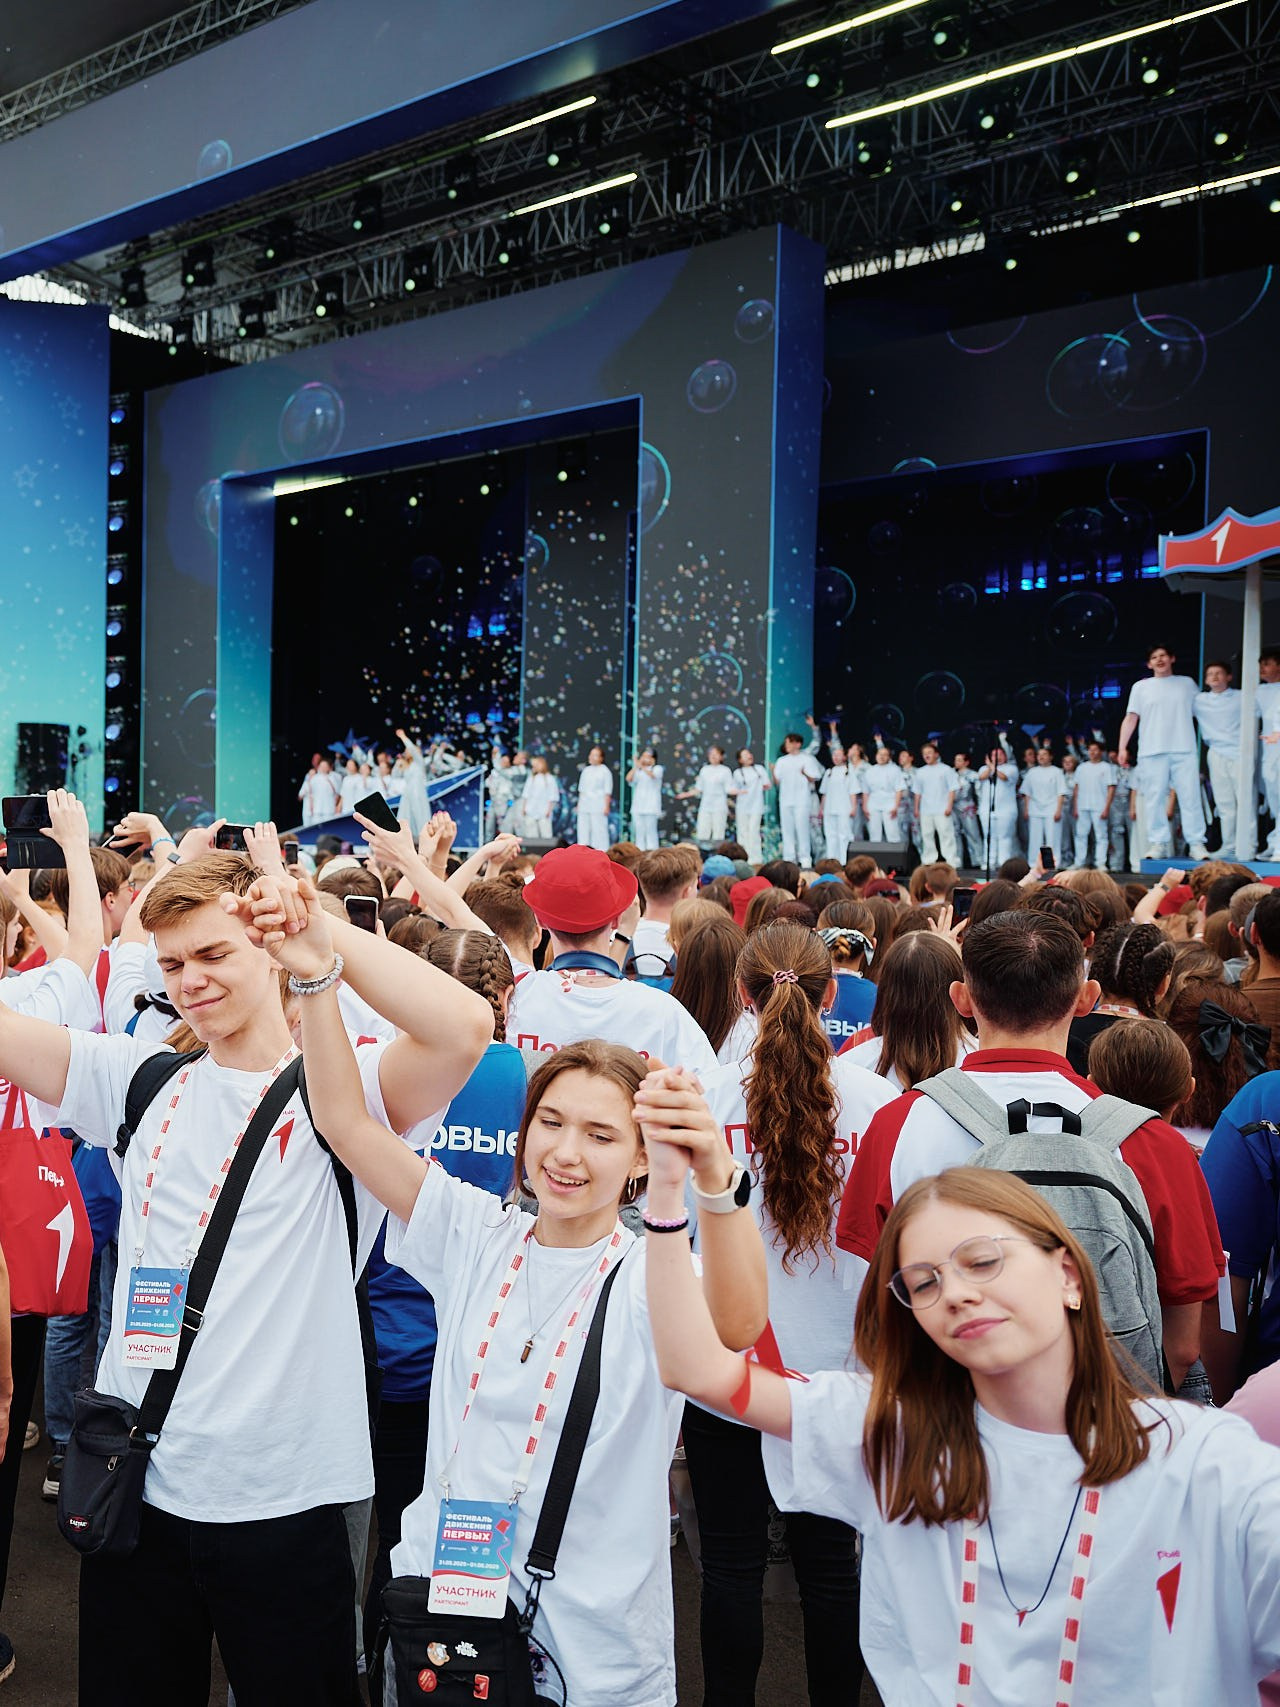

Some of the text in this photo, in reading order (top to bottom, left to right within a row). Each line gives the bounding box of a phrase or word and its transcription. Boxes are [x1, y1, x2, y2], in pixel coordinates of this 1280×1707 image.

[424, 1124, 520, 1158] рвые
[134, 1295, 169, 1304] ПЕРВЫХ
[128, 1344, 172, 1354] УЧАСТНИК
[446, 1513, 493, 1523] ФЕСТИВАЛЬ
[444, 1521, 492, 1530] ДВИЖЕНИЯ
[443, 1530, 491, 1541] ПЕРВЫХ
[436, 1585, 496, 1599] УЧАСТНИК
